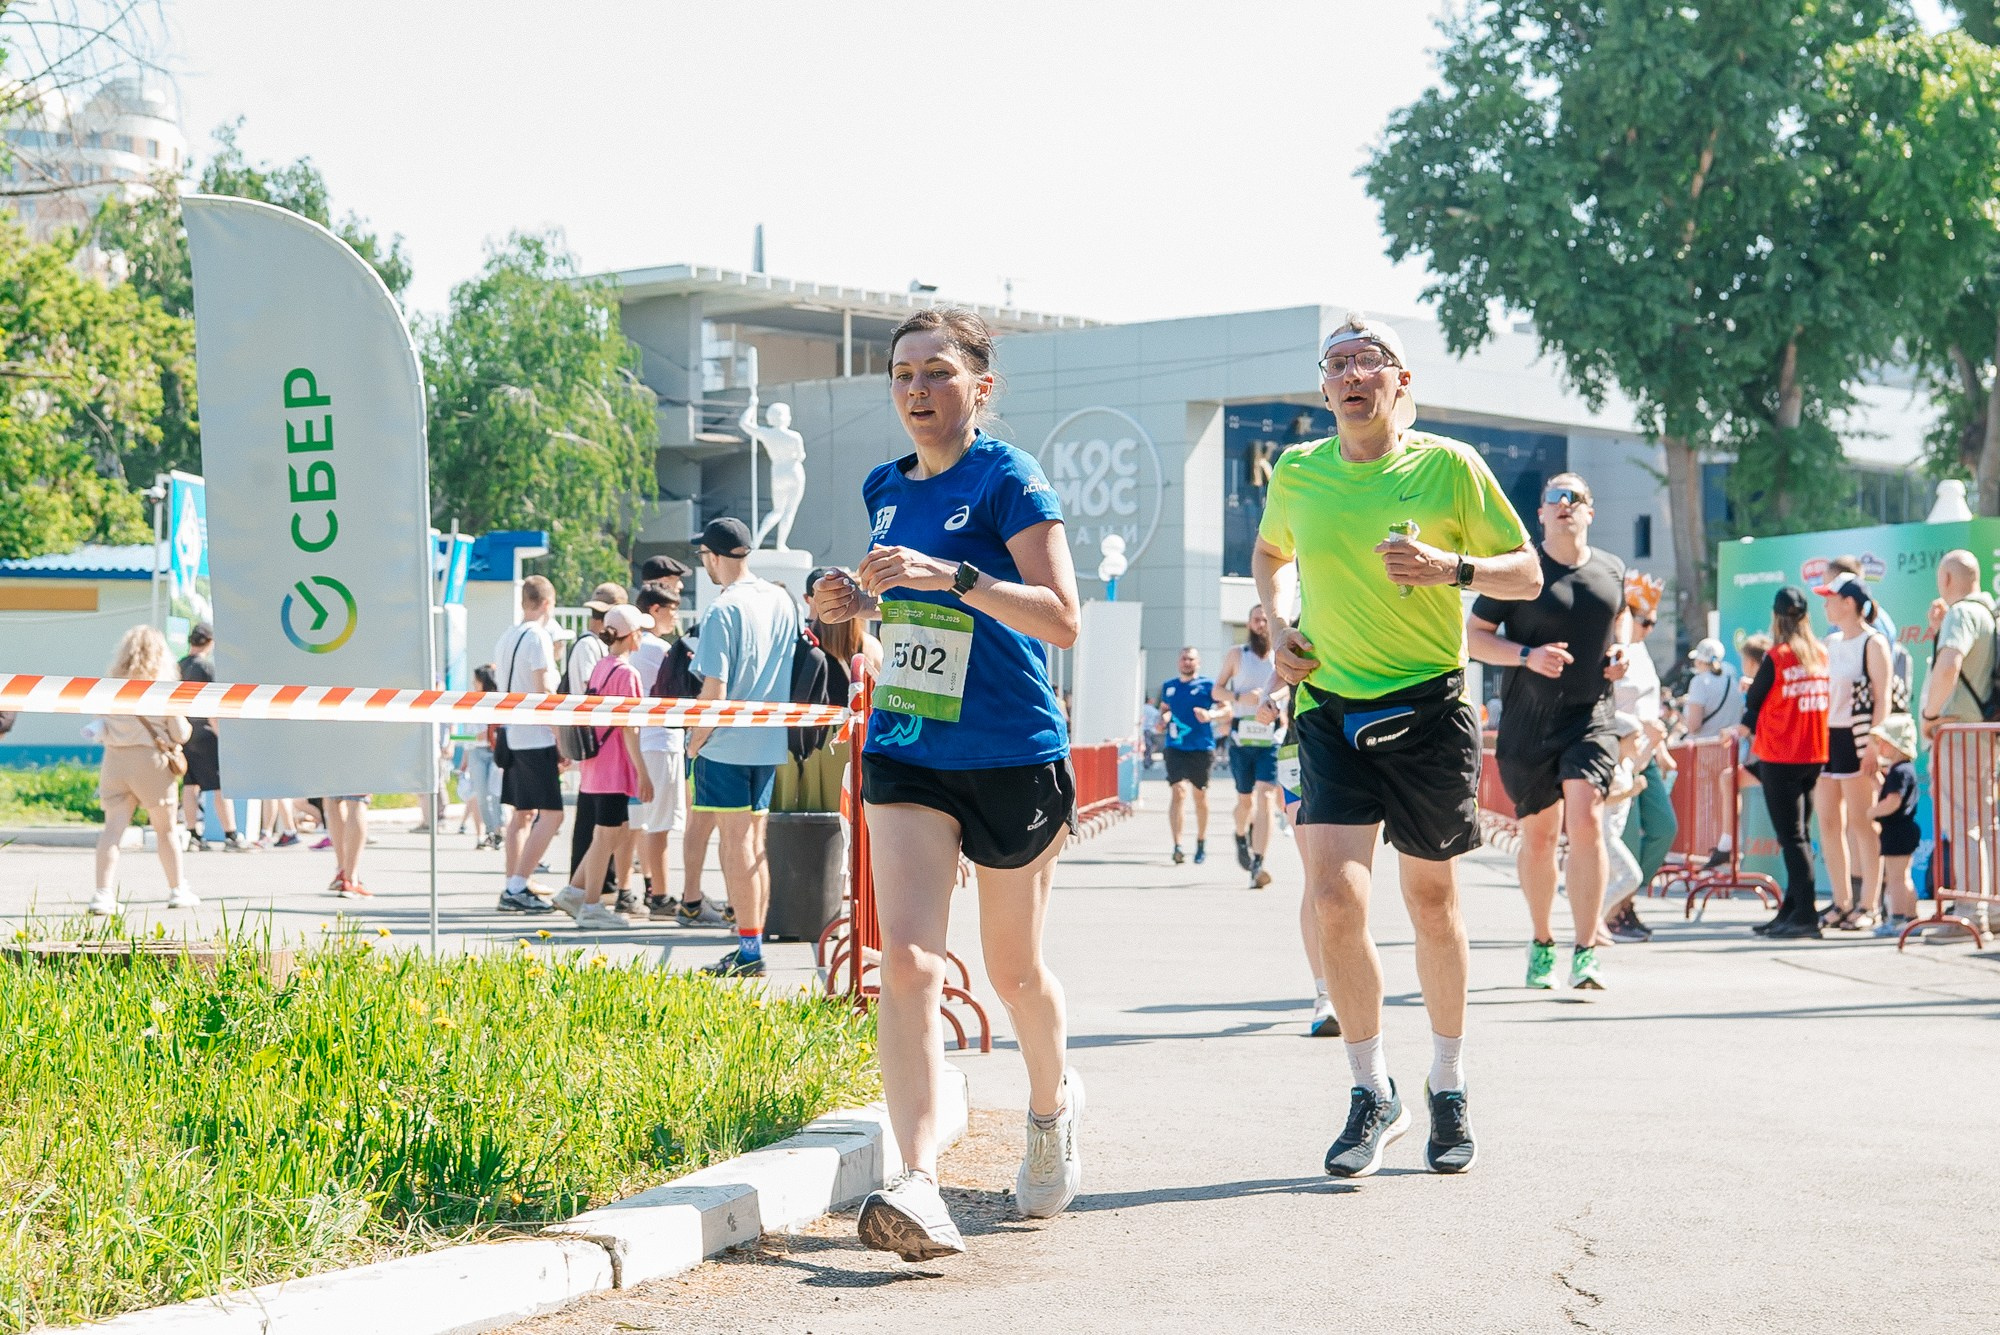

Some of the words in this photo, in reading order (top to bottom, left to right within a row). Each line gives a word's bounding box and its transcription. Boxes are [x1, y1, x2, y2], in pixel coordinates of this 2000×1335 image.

[284, 368, 338, 552] СБЕР
[1053, 439, 1139, 479] КОС
[1053, 478, 1138, 516] МОС
